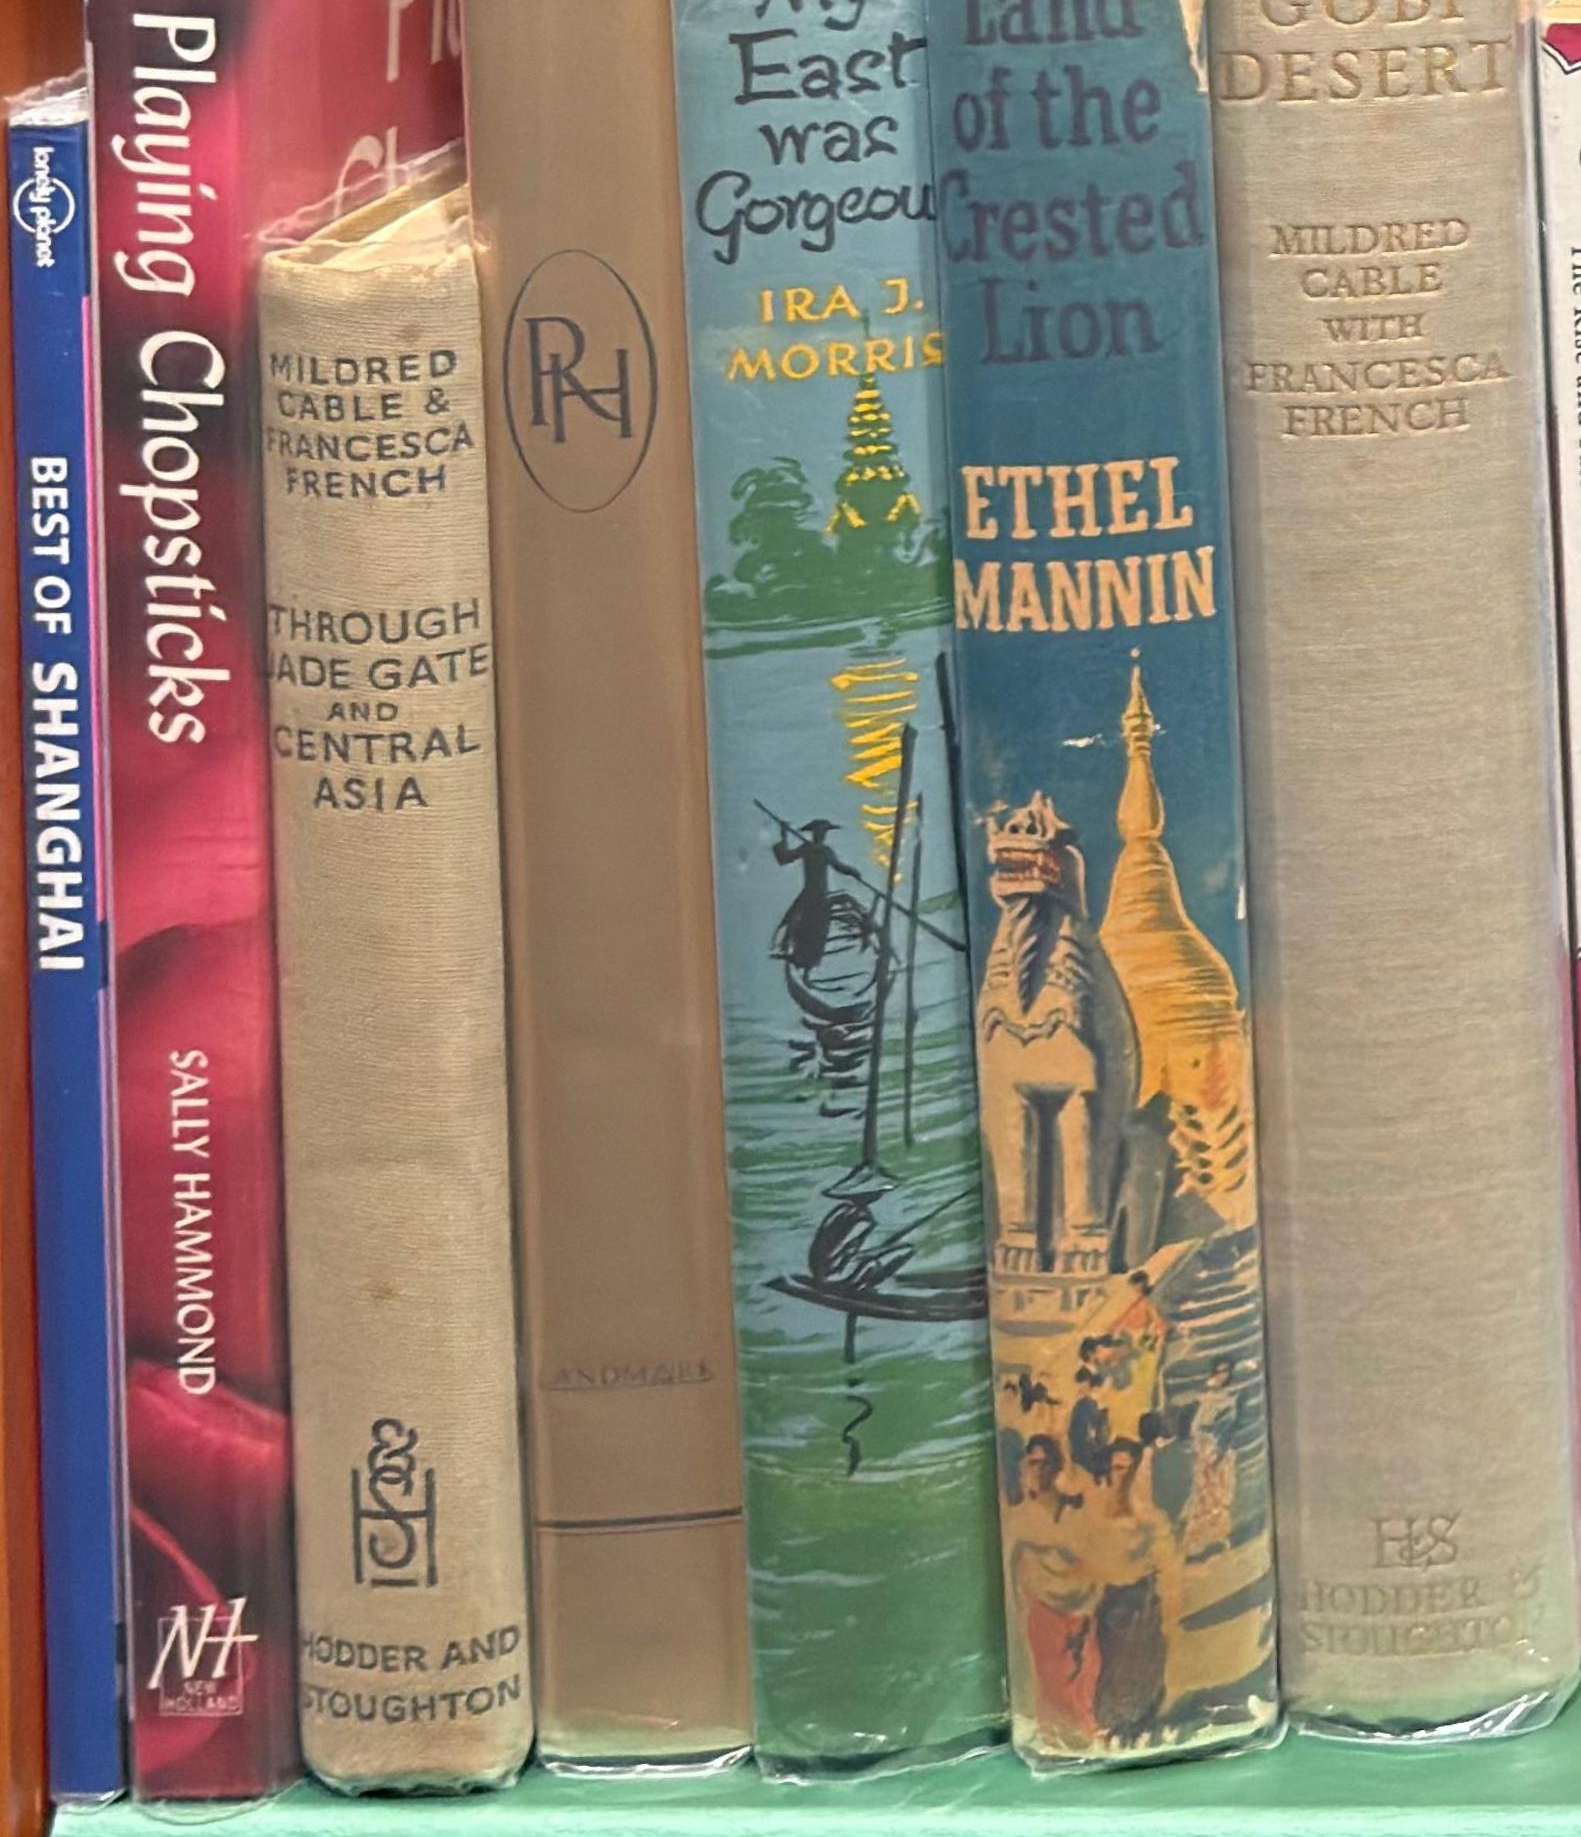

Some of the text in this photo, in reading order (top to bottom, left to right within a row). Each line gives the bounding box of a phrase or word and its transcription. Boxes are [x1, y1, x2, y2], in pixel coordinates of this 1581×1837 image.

[729, 29, 928, 106] East
[1222, 37, 1512, 105] DESERT
[952, 64, 1160, 153] of the
[760, 278, 923, 324] IRA J.
[1301, 261, 1444, 302] CABLE
[979, 278, 1165, 365] Lion
[1322, 311, 1424, 344] WITH
[112, 11, 232, 744] Playing Chopsticks
[270, 349, 457, 383] MILDRED
[1282, 398, 1470, 440] FRENCH
[265, 428, 474, 459] FRANCESCA
[285, 465, 448, 499] FRENCH
[956, 547, 1216, 631] MANNIN
[373, 644, 491, 685] GATE
[29, 457, 86, 970] BEST OF SHANGHAI
[275, 723, 481, 759] CENTRAL
[314, 779, 427, 811] ASIA
